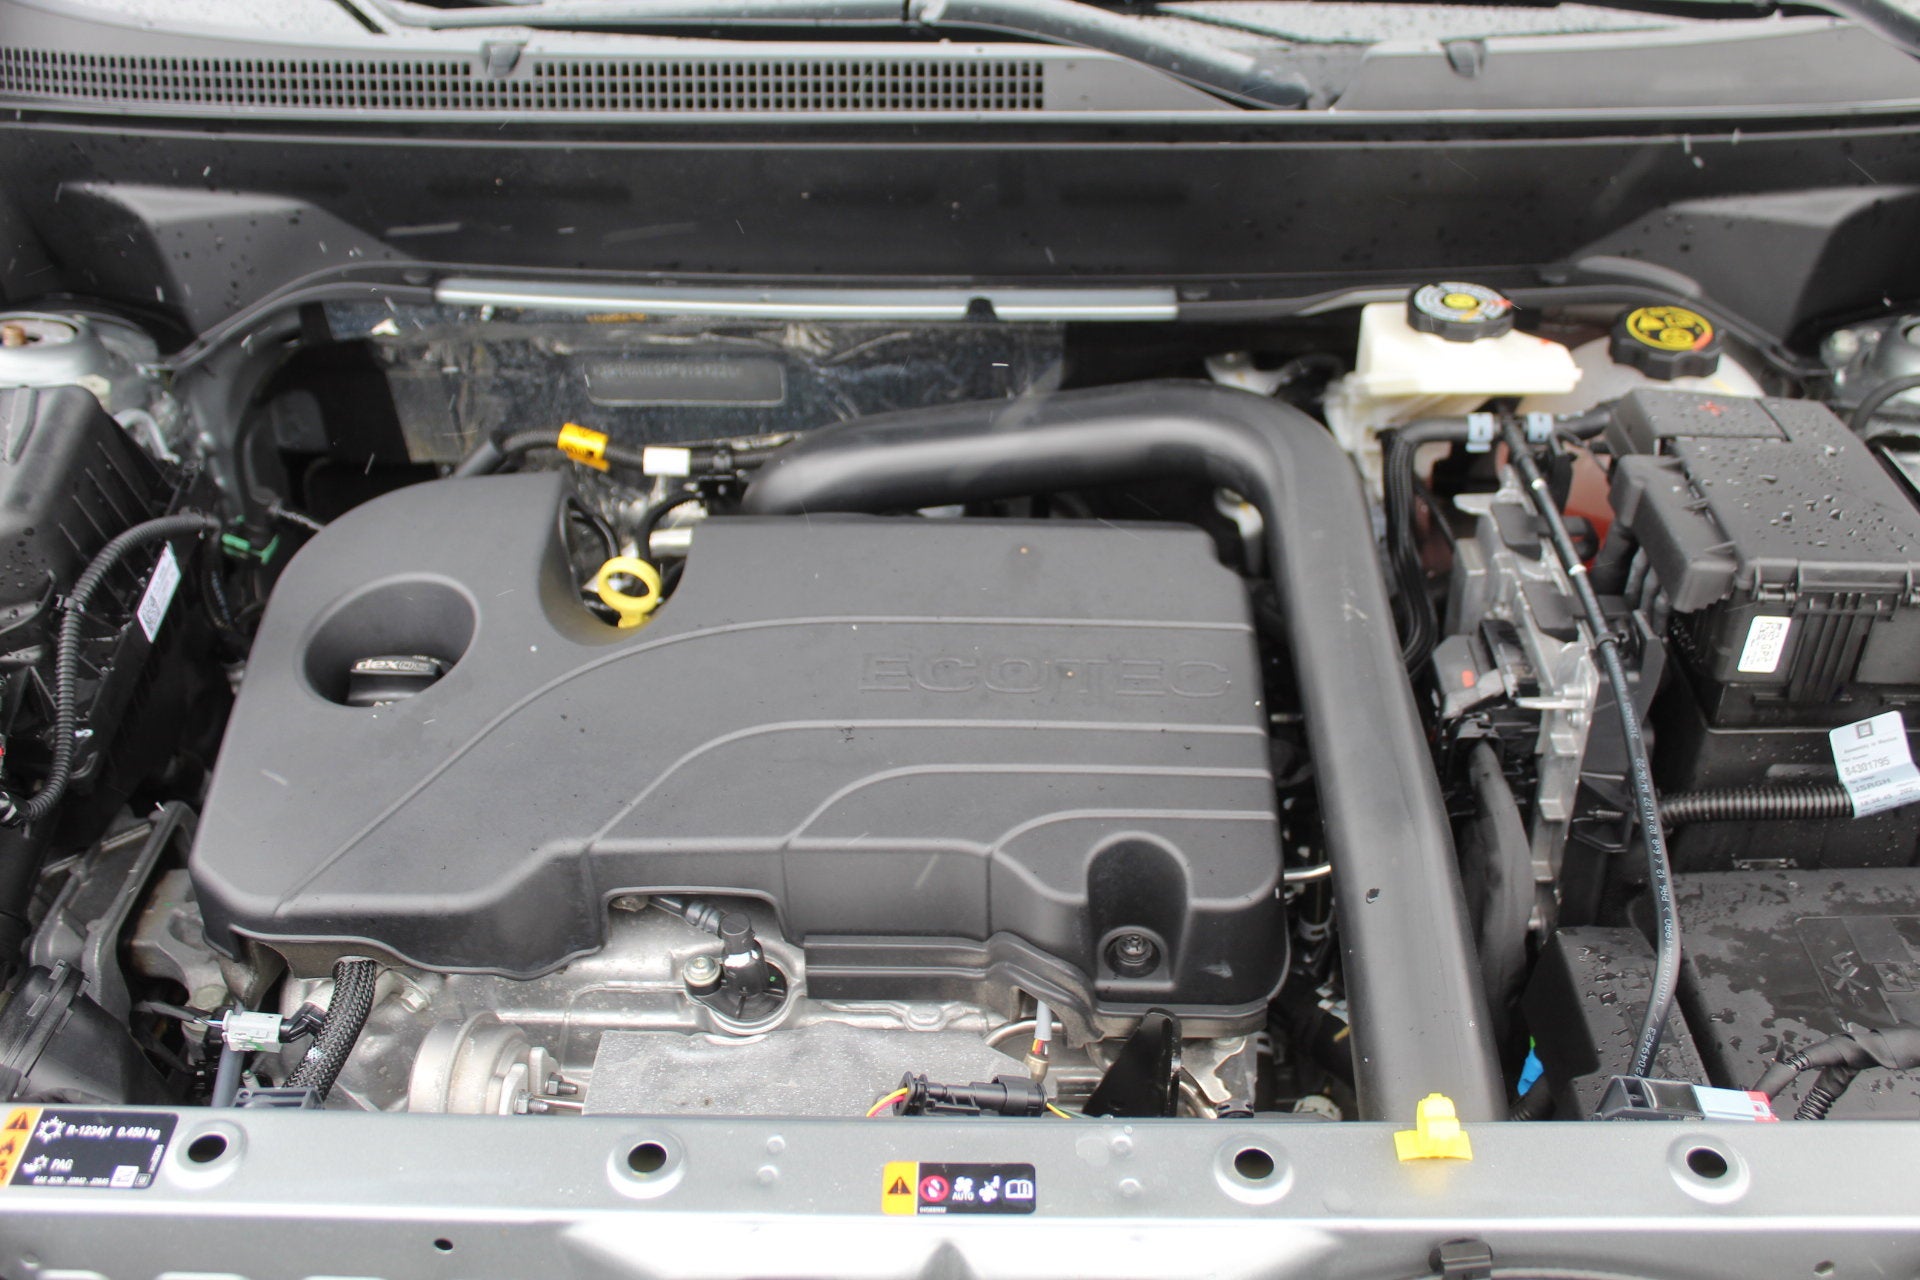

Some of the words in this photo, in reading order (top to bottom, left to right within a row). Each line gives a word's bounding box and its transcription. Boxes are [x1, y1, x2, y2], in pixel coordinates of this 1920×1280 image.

[356, 659, 428, 671] dexos
[859, 655, 1230, 698] ECOTEC
[116, 1126, 147, 1139] 0.450
[145, 1127, 161, 1142] kg
[51, 1158, 74, 1171] PAG
[952, 1191, 975, 1201] AUTO
